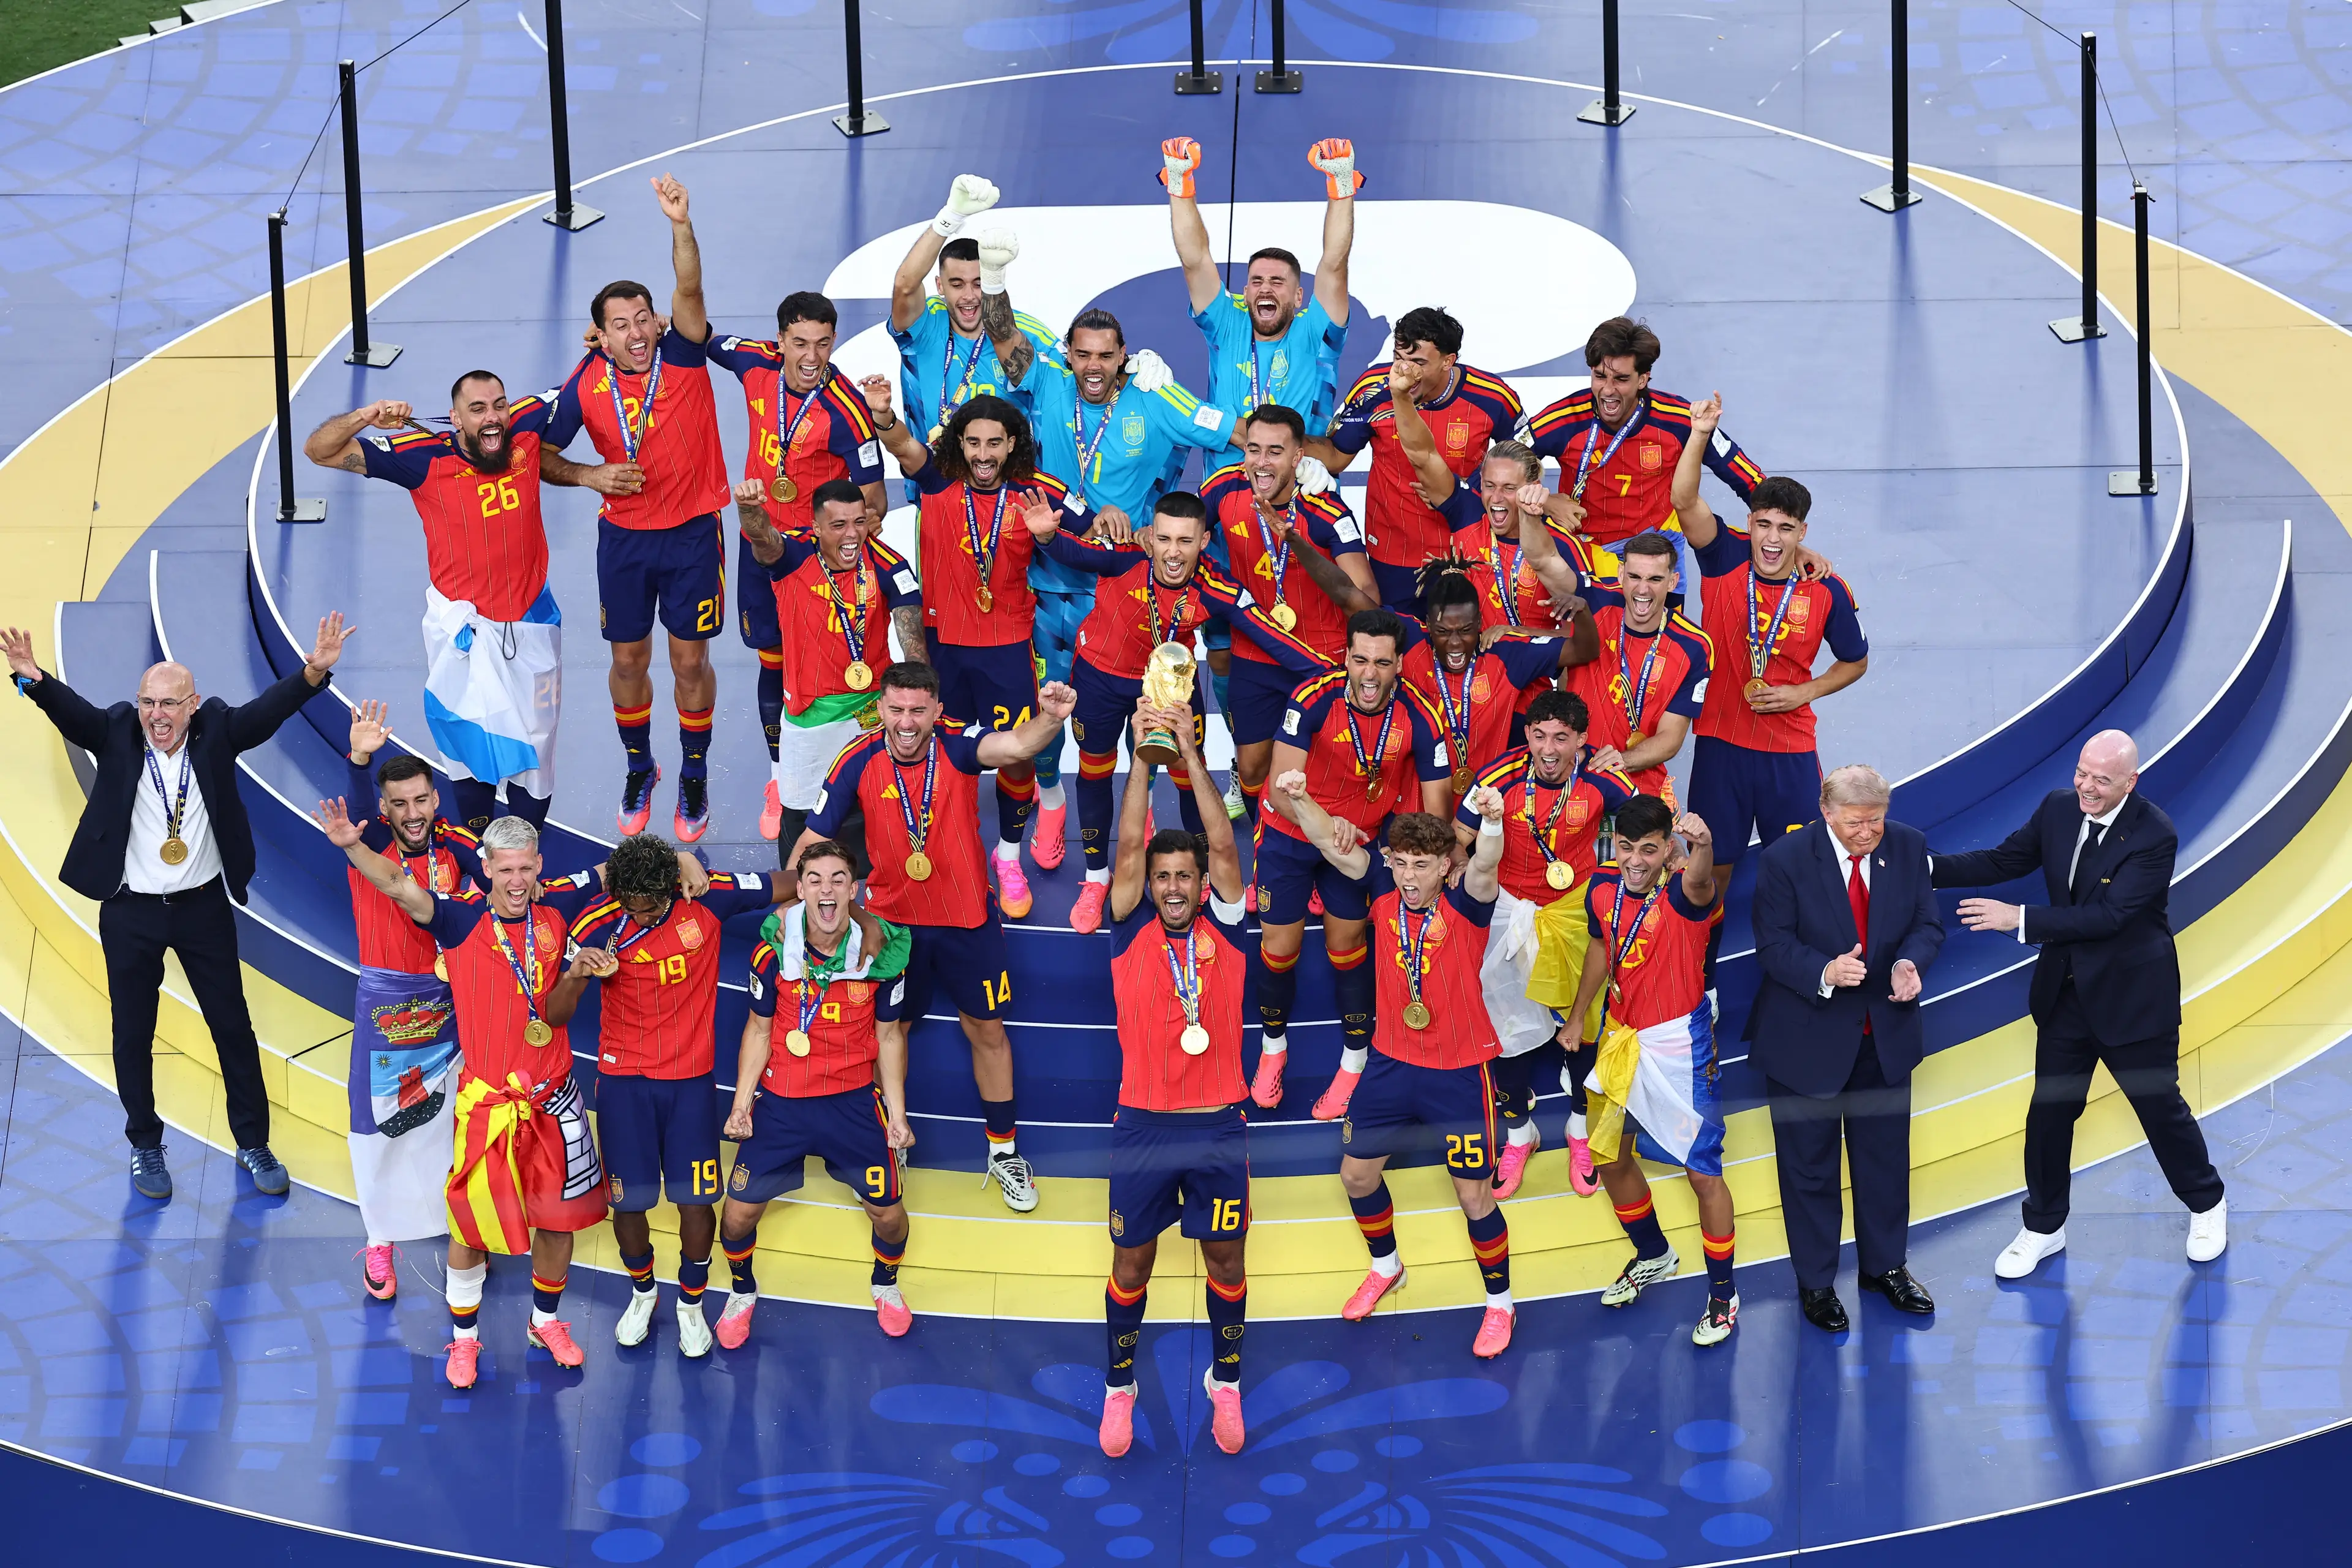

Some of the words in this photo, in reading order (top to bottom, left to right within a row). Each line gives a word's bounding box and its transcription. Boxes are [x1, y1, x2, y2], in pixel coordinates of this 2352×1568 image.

[976, 330, 985, 347] WORLD
[1442, 380, 1453, 398] WORLD
[790, 415, 801, 432] WORLD
[804, 390, 816, 407] 2026
[622, 426, 630, 447] 2026
[759, 428, 780, 467] 18
[1095, 428, 1104, 445] 2026
[1580, 451, 1589, 472] WORLD
[1589, 423, 1598, 442] 2026
[1602, 451, 1611, 462] FIFA
[1609, 435, 1622, 452] WORLD
[1626, 410, 1640, 428] 2026
[1093, 452, 1102, 484] 1
[478, 475, 519, 518] 26
[1615, 474, 1632, 497] 7
[1262, 527, 1272, 545] 2026
[1254, 552, 1274, 581] 4
[697, 594, 720, 631] 21
[1499, 589, 1509, 608] WORLD
[1771, 614, 1781, 633] WORLD
[1783, 586, 1792, 604] 2026
[827, 601, 856, 633] 12
[840, 612, 850, 629] 2026
[850, 640, 858, 658] WORLD
[1642, 661, 1651, 679] 2026
[1439, 679, 1449, 698] WORLD
[1448, 709, 1457, 728] 2026
[993, 705, 1031, 732] 24
[1193, 714, 1204, 745] 3
[153, 767, 162, 789] WORLD
[1543, 848, 1555, 862] WORLD
[625, 937, 635, 946] WORLD
[638, 927, 649, 936] 2026
[1630, 921, 1640, 938] WORLD
[1619, 946, 1629, 962] 2026
[515, 967, 524, 980] FIFA
[521, 978, 533, 997] WORLD
[657, 954, 687, 986] 19
[1172, 960, 1181, 980] WORLD
[982, 970, 1011, 1011] 14
[810, 1003, 818, 1014] FIFA
[821, 1002, 840, 1023] 9
[1446, 1133, 1483, 1168] 25
[692, 1159, 717, 1195] 19
[865, 1166, 885, 1198] 9
[1211, 1198, 1241, 1231] 16
